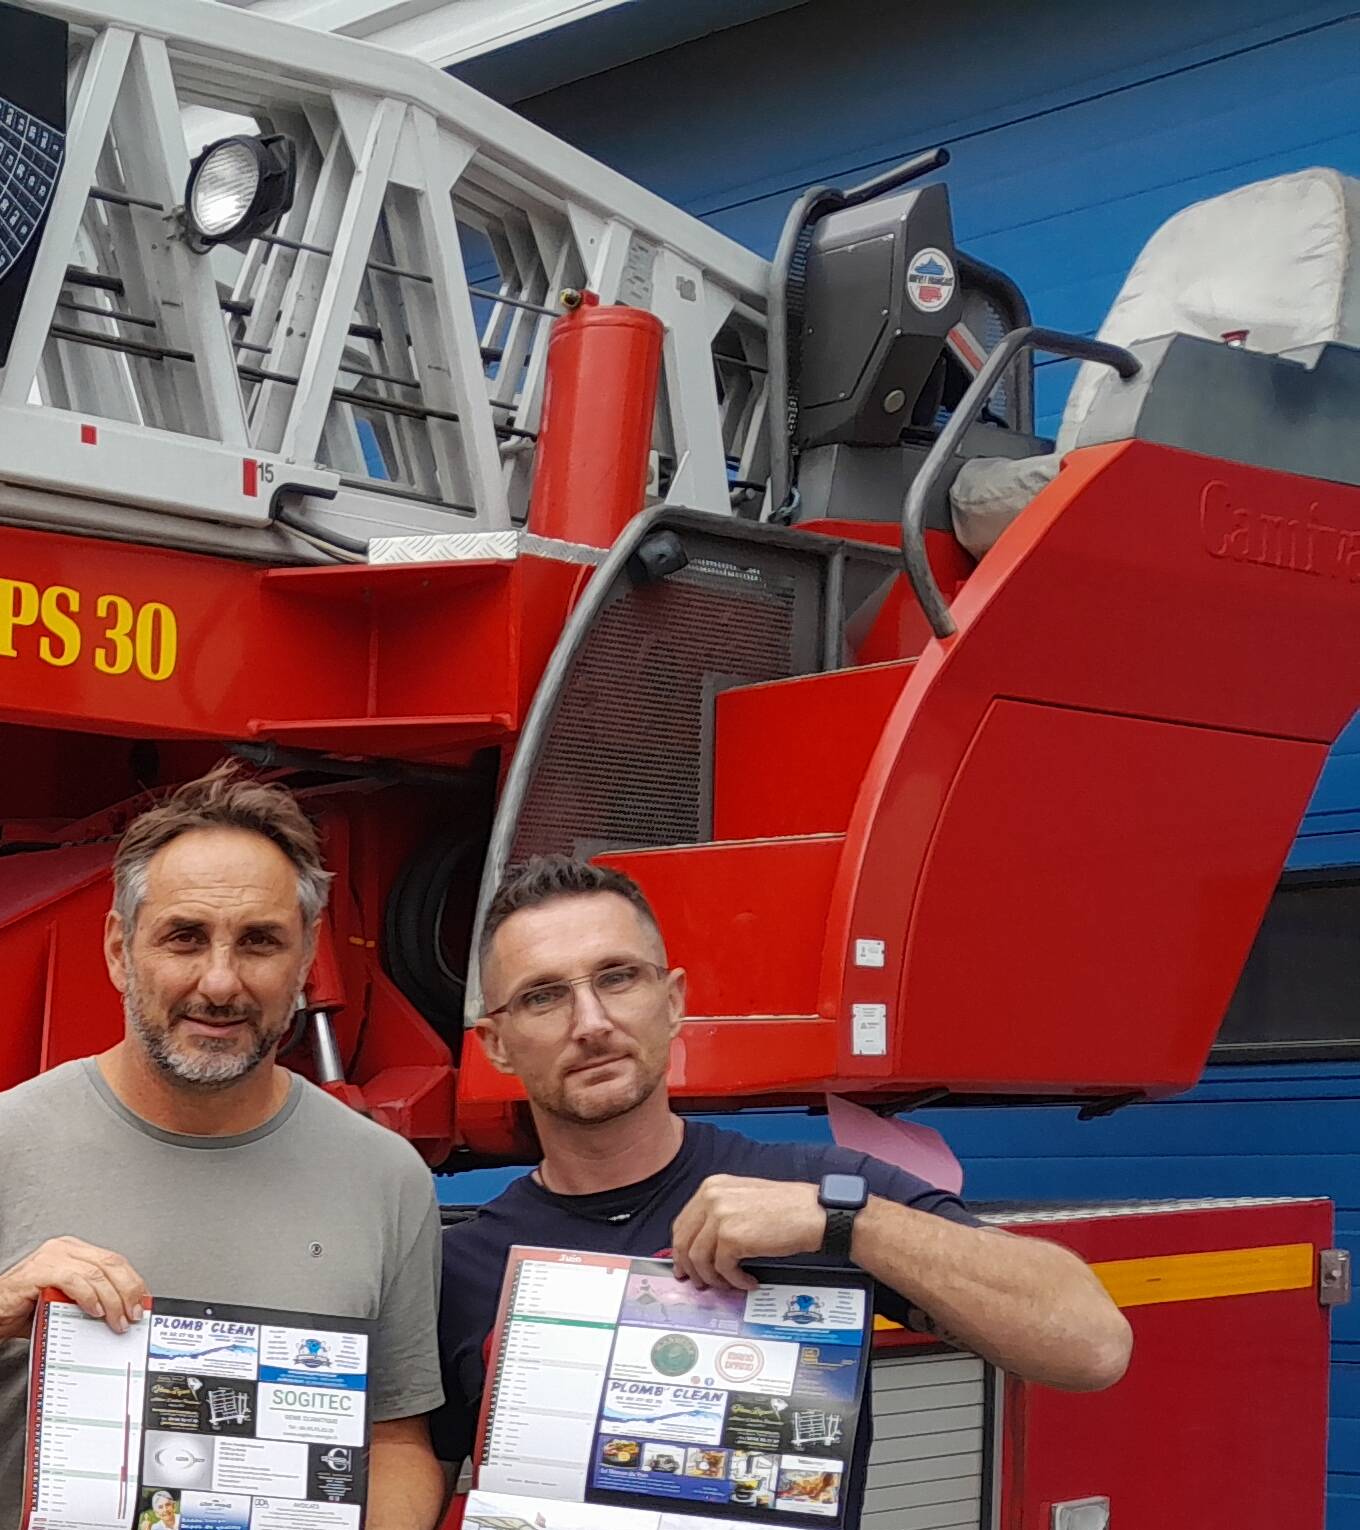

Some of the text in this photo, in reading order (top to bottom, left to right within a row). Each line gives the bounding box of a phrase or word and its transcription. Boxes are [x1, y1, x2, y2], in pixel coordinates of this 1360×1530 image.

[257, 462, 274, 484] 15
[95, 594, 177, 681] 30
[210, 1322, 256, 1336] CLEAN
[272, 1389, 352, 1411] SOGITEC
[672, 1388, 724, 1402] CLEAN
